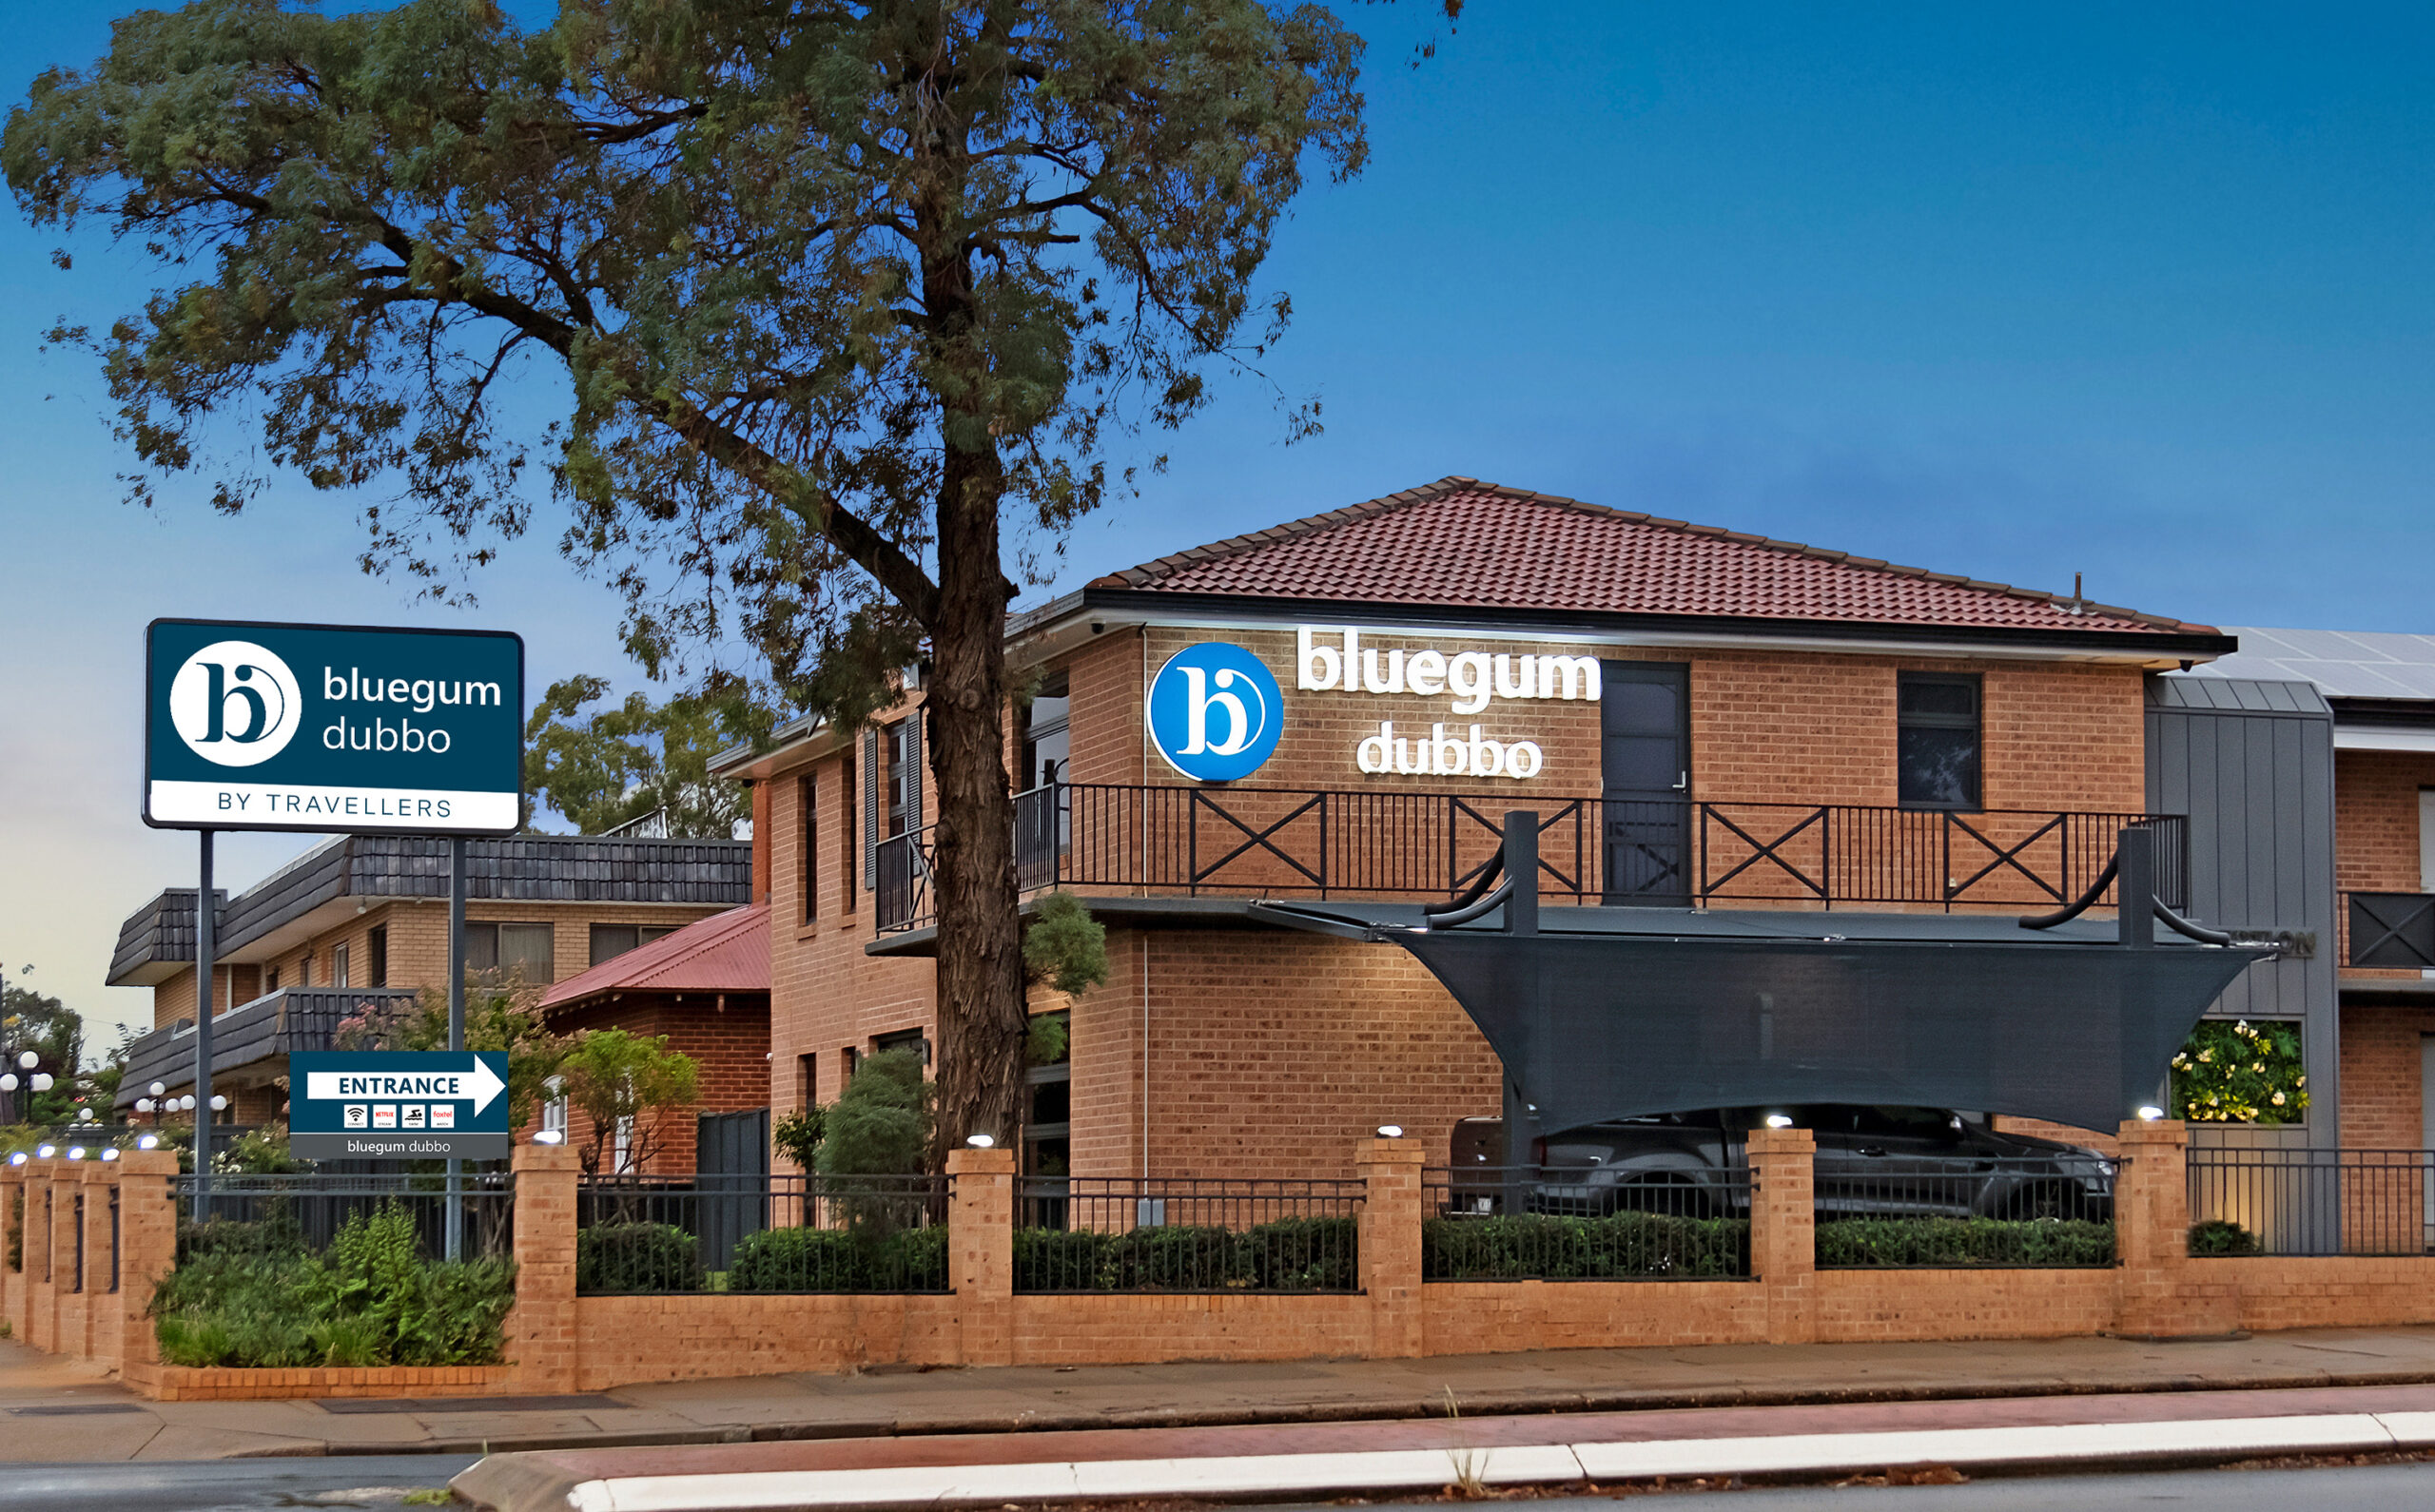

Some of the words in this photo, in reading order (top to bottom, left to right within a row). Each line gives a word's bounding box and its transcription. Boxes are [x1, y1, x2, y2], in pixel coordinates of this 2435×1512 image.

[1296, 625, 1603, 715] bluegum
[323, 666, 502, 713] bluegum
[322, 715, 452, 754] dubbo
[1355, 720, 1544, 780] dubbo
[218, 792, 251, 810] BY
[266, 793, 452, 818] TRAVELLERS
[339, 1077, 459, 1095] ENTRANCE
[433, 1110, 453, 1118] foxtel
[347, 1139, 405, 1155] bluegum
[408, 1139, 452, 1153] dubbo
